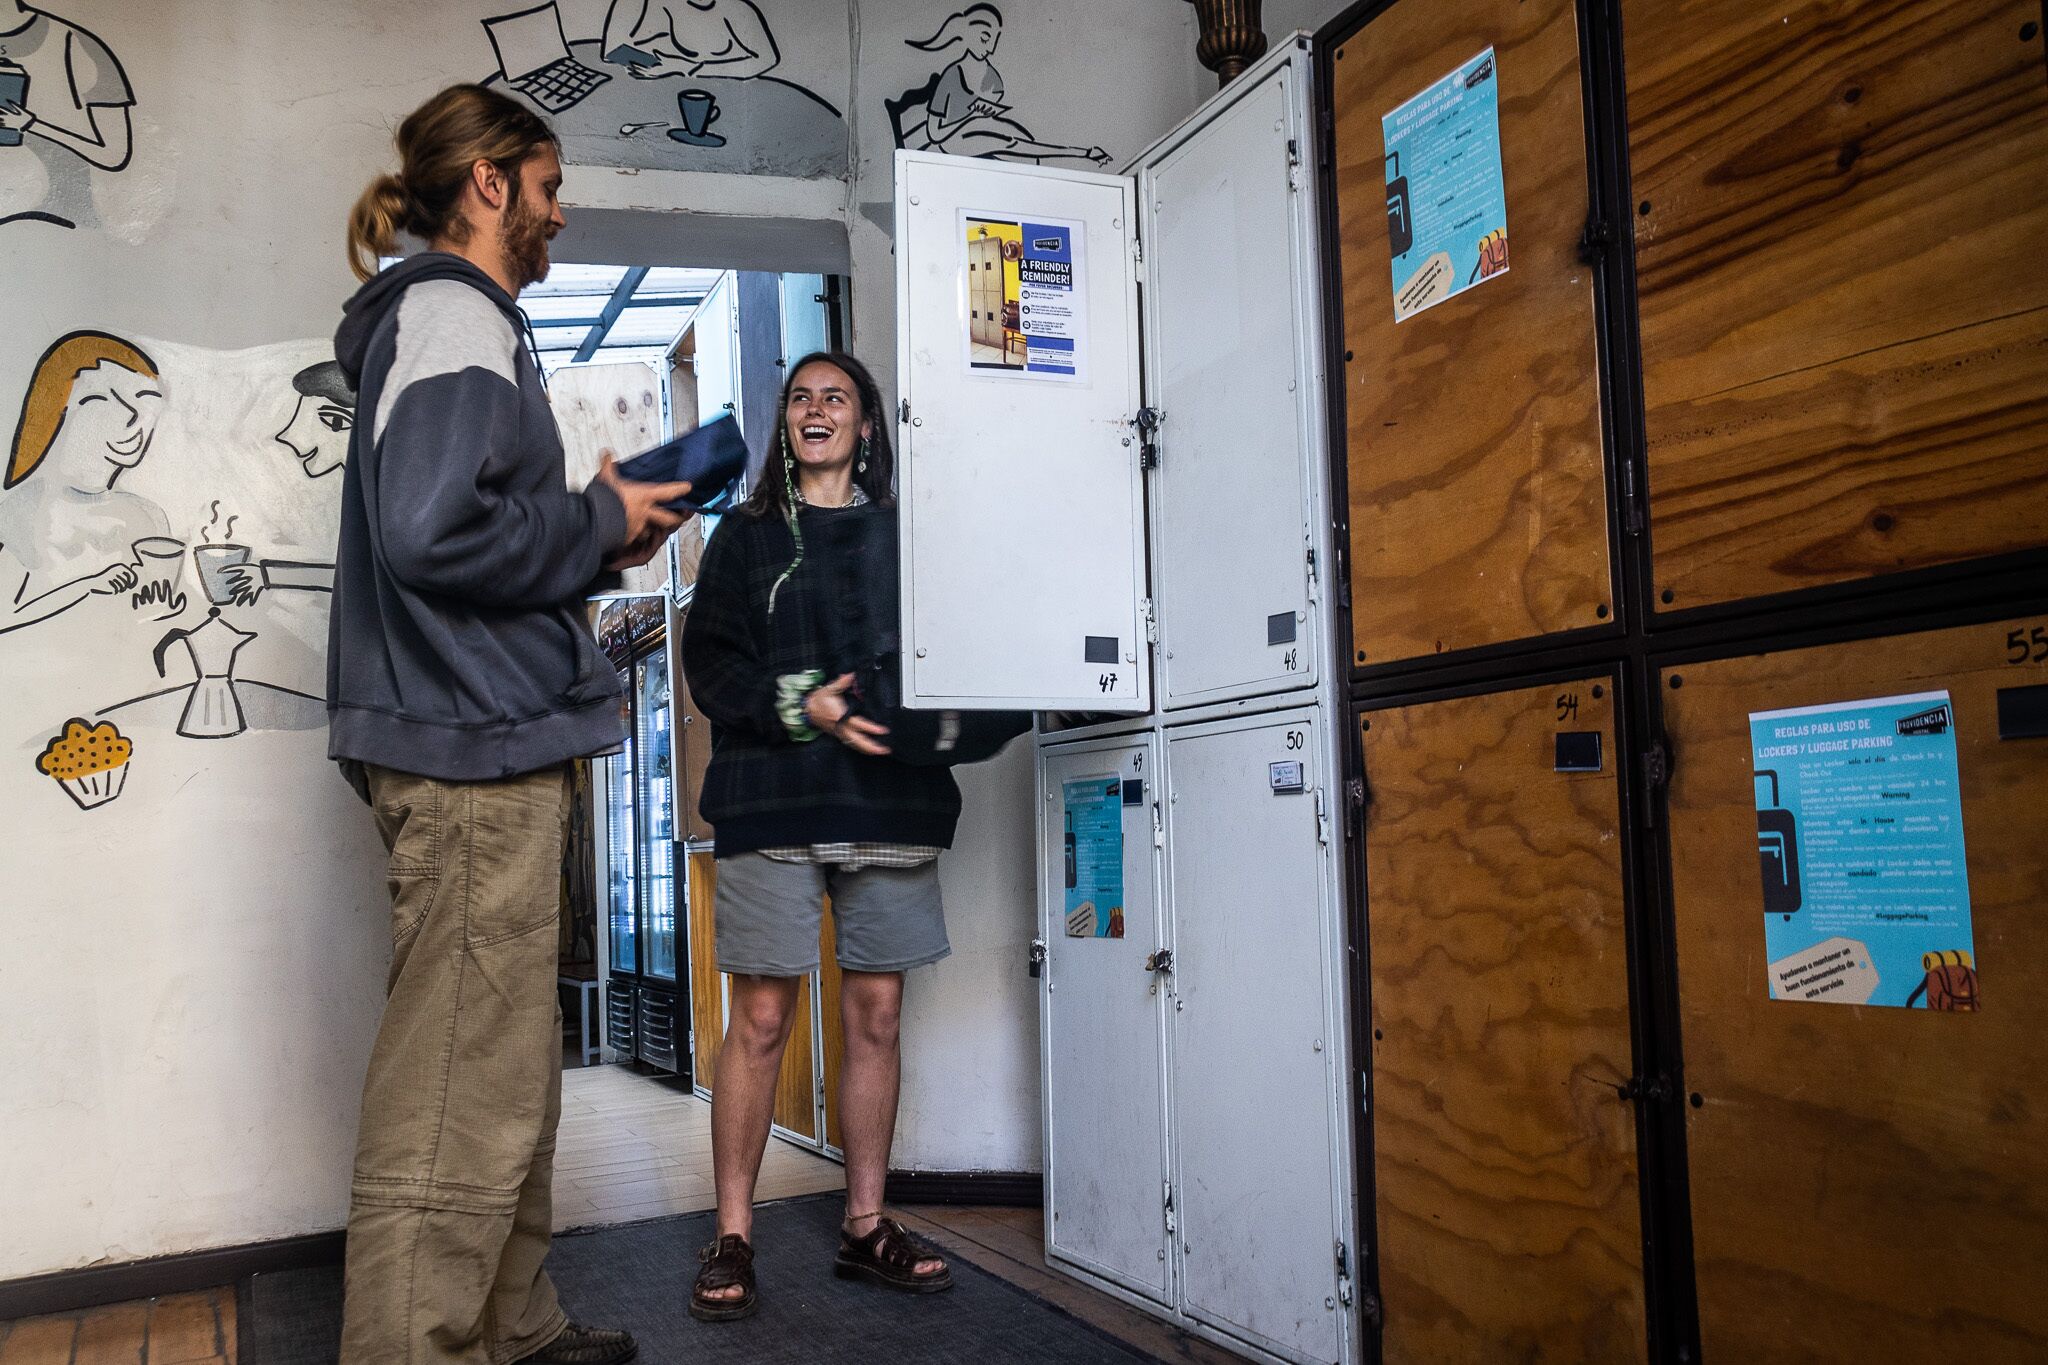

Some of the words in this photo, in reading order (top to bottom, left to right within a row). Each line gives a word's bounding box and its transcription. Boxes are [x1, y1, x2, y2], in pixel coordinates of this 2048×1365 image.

[1397, 108, 1417, 126] REGLAS
[1417, 98, 1431, 113] PARA
[1431, 91, 1443, 105] USO
[1443, 86, 1451, 97] DE
[1387, 125, 1411, 146] LOCKERS
[1416, 107, 1439, 128] LUGGAGE
[1440, 93, 1464, 112] PARKING
[1021, 259, 1027, 269] A
[1030, 261, 1070, 273] FRIENDLY
[1022, 271, 1070, 285] REMINDER!
[2006, 626, 2048, 664] 55
[1284, 648, 1297, 671] 48
[1099, 673, 1118, 693] 47
[1556, 692, 1578, 721] 54
[1775, 726, 1809, 739] REGLAS
[1811, 722, 1834, 735] PARA
[1837, 720, 1856, 732] USO
[1858, 718, 1871, 730] DE
[1900, 712, 1945, 729] PROVIDENCIA
[1286, 730, 1304, 750] 50
[1759, 744, 1798, 758] LOCKERS
[1808, 739, 1850, 754] LUGGAGE
[1852, 736, 1893, 749] PARKING
[1133, 752, 1143, 772] 49
[1902, 752, 1924, 760] Check
[1881, 792, 1911, 800] Warning
[1780, 965, 1808, 981] Ayudanos
[1813, 951, 1841, 967] mantener
[1842, 948, 1851, 956] un
[1785, 982, 1800, 992] buen
[1800, 964, 1846, 986] funcionamiento
[1846, 960, 1855, 968] de
[1805, 988, 1820, 998] este
[1820, 978, 1844, 993] servicio
